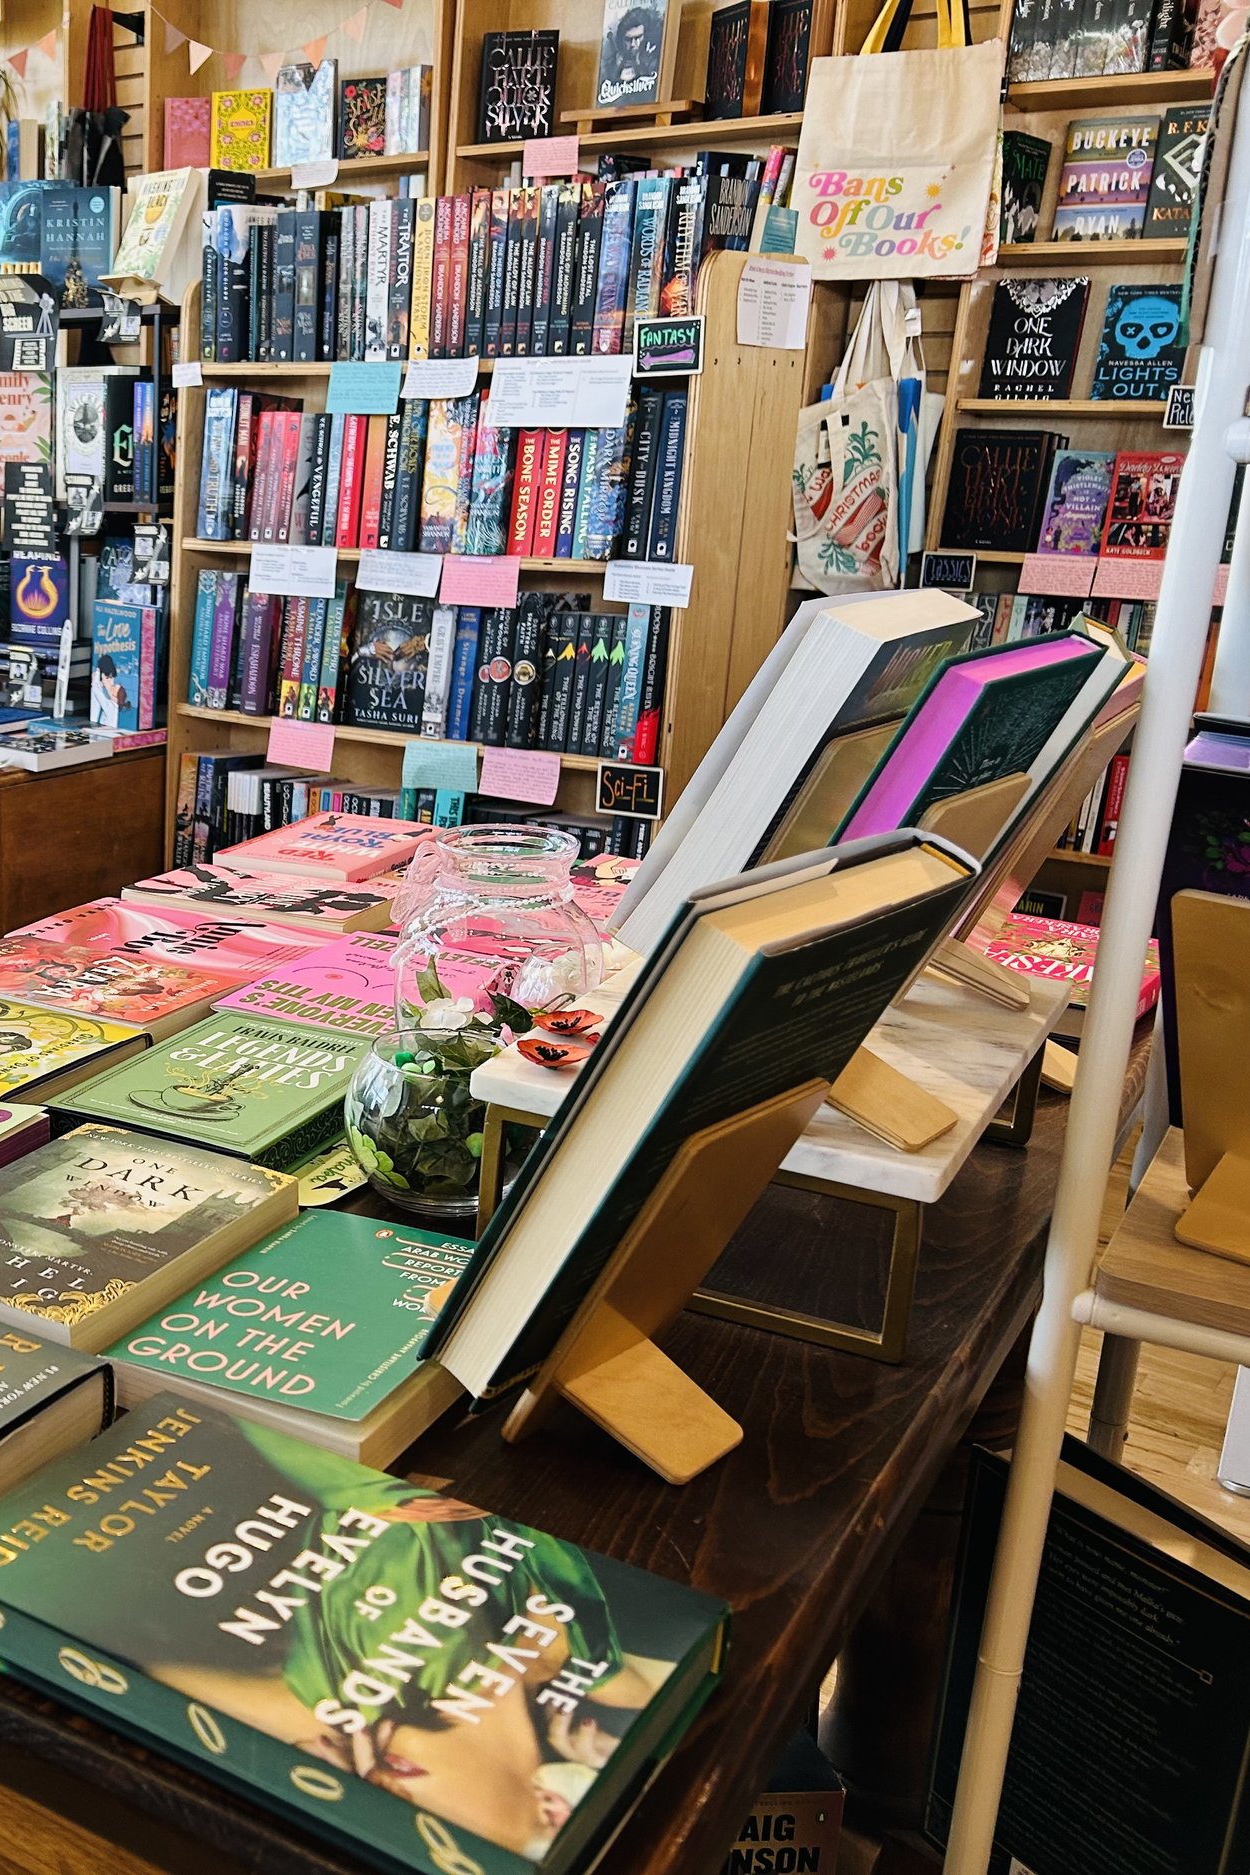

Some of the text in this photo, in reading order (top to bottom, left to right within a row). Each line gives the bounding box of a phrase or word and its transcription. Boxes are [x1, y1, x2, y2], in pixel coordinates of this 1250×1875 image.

[598, 71, 658, 103] Quicksilver
[484, 105, 548, 138] SILVER
[1072, 127, 1151, 152] BUCKEYE
[719, 177, 748, 203] BRANDON
[809, 172, 904, 204] Bans
[1067, 171, 1142, 194] PATRICK
[46, 218, 105, 228] KRISTIN
[709, 205, 752, 236] SANDERSON
[809, 199, 942, 239] Off Our
[1074, 215, 1120, 233] RYAN
[45, 231, 105, 242] HANNAH
[839, 226, 972, 259] Books!
[376, 226, 389, 286] MARTYR
[395, 223, 412, 288] TRAITOR
[585, 273, 593, 297] METAL
[449, 264, 462, 344] BRANDON SANDERSON
[639, 327, 695, 346] FANTASY
[1014, 318, 1052, 336] ONE
[1006, 339, 1052, 357] DARK
[990, 359, 1066, 378] WINDOW
[1098, 367, 1178, 381] LIGHTS
[995, 383, 1054, 393] RACHEL
[1113, 383, 1156, 397] OUT
[384, 431, 398, 490] SCHWAB
[632, 431, 651, 505] CITY DUSK
[660, 421, 681, 514] MIDNIGHT KINGDOM
[1119, 462, 1151, 473] Daddy
[309, 465, 323, 527] VENGEFUL
[514, 444, 535, 540] BONE SEASON
[539, 447, 560, 538] MIME ORDER
[559, 444, 581, 535] SONG RISING
[1066, 503, 1100, 511] VILLAIN
[925, 557, 973, 583] Classics
[372, 600, 424, 623] ISLE
[105, 618, 131, 640] Love
[291, 637, 303, 677] THRONE
[357, 664, 425, 690] SILVER
[369, 689, 408, 710] SEA
[354, 709, 419, 724] TASHA SURI
[571, 691, 583, 742] TWO TOWERS
[263, 782, 271, 830] BEAUTYLAND
[602, 770, 648, 811] Sci-Fi
[278, 849, 336, 864] RED
[300, 831, 387, 850] ROYAL
[32, 954, 150, 1000] ZHARA
[253, 979, 360, 1010] MY TITS
[239, 992, 394, 1037] EVERYONE'S
[39, 1032, 93, 1058] GUARDIANS
[197, 1032, 358, 1072] LEGENDS
[232, 1027, 356, 1053] TRAVIS BALDREE
[169, 1046, 333, 1089] & LATTES
[110, 1138, 135, 1147] YORK
[137, 1146, 165, 1156] TIMES
[165, 1153, 229, 1175] BESTSELLING
[231, 1172, 264, 1185] SERIES
[133, 1158, 178, 1175] ONE
[66, 1173, 162, 1209] WINDOW
[74, 1157, 205, 1202] DARK
[48, 1254, 94, 1276] MARTYR.
[401, 1246, 439, 1258] ARAB
[221, 1271, 312, 1301] OUR
[399, 1272, 447, 1286] FROM
[193, 1290, 356, 1341] WOMEN
[160, 1313, 316, 1364] ON THE
[22, 1372, 47, 1391] NEW
[126, 1336, 316, 1397] GROUND
[369, 1352, 400, 1381] CHRISTIANE
[66, 1406, 202, 1506] JENKINS
[72, 1459, 213, 1553] TAYLOR
[164, 1512, 204, 1543] NOVEL
[174, 1493, 312, 1599] HUGO
[218, 1505, 392, 1646] EVELYN
[354, 1586, 398, 1622] OF
[314, 1528, 537, 1735] HUSBANDS
[431, 1594, 576, 1725] SEVEN
[537, 1656, 609, 1716] THE
